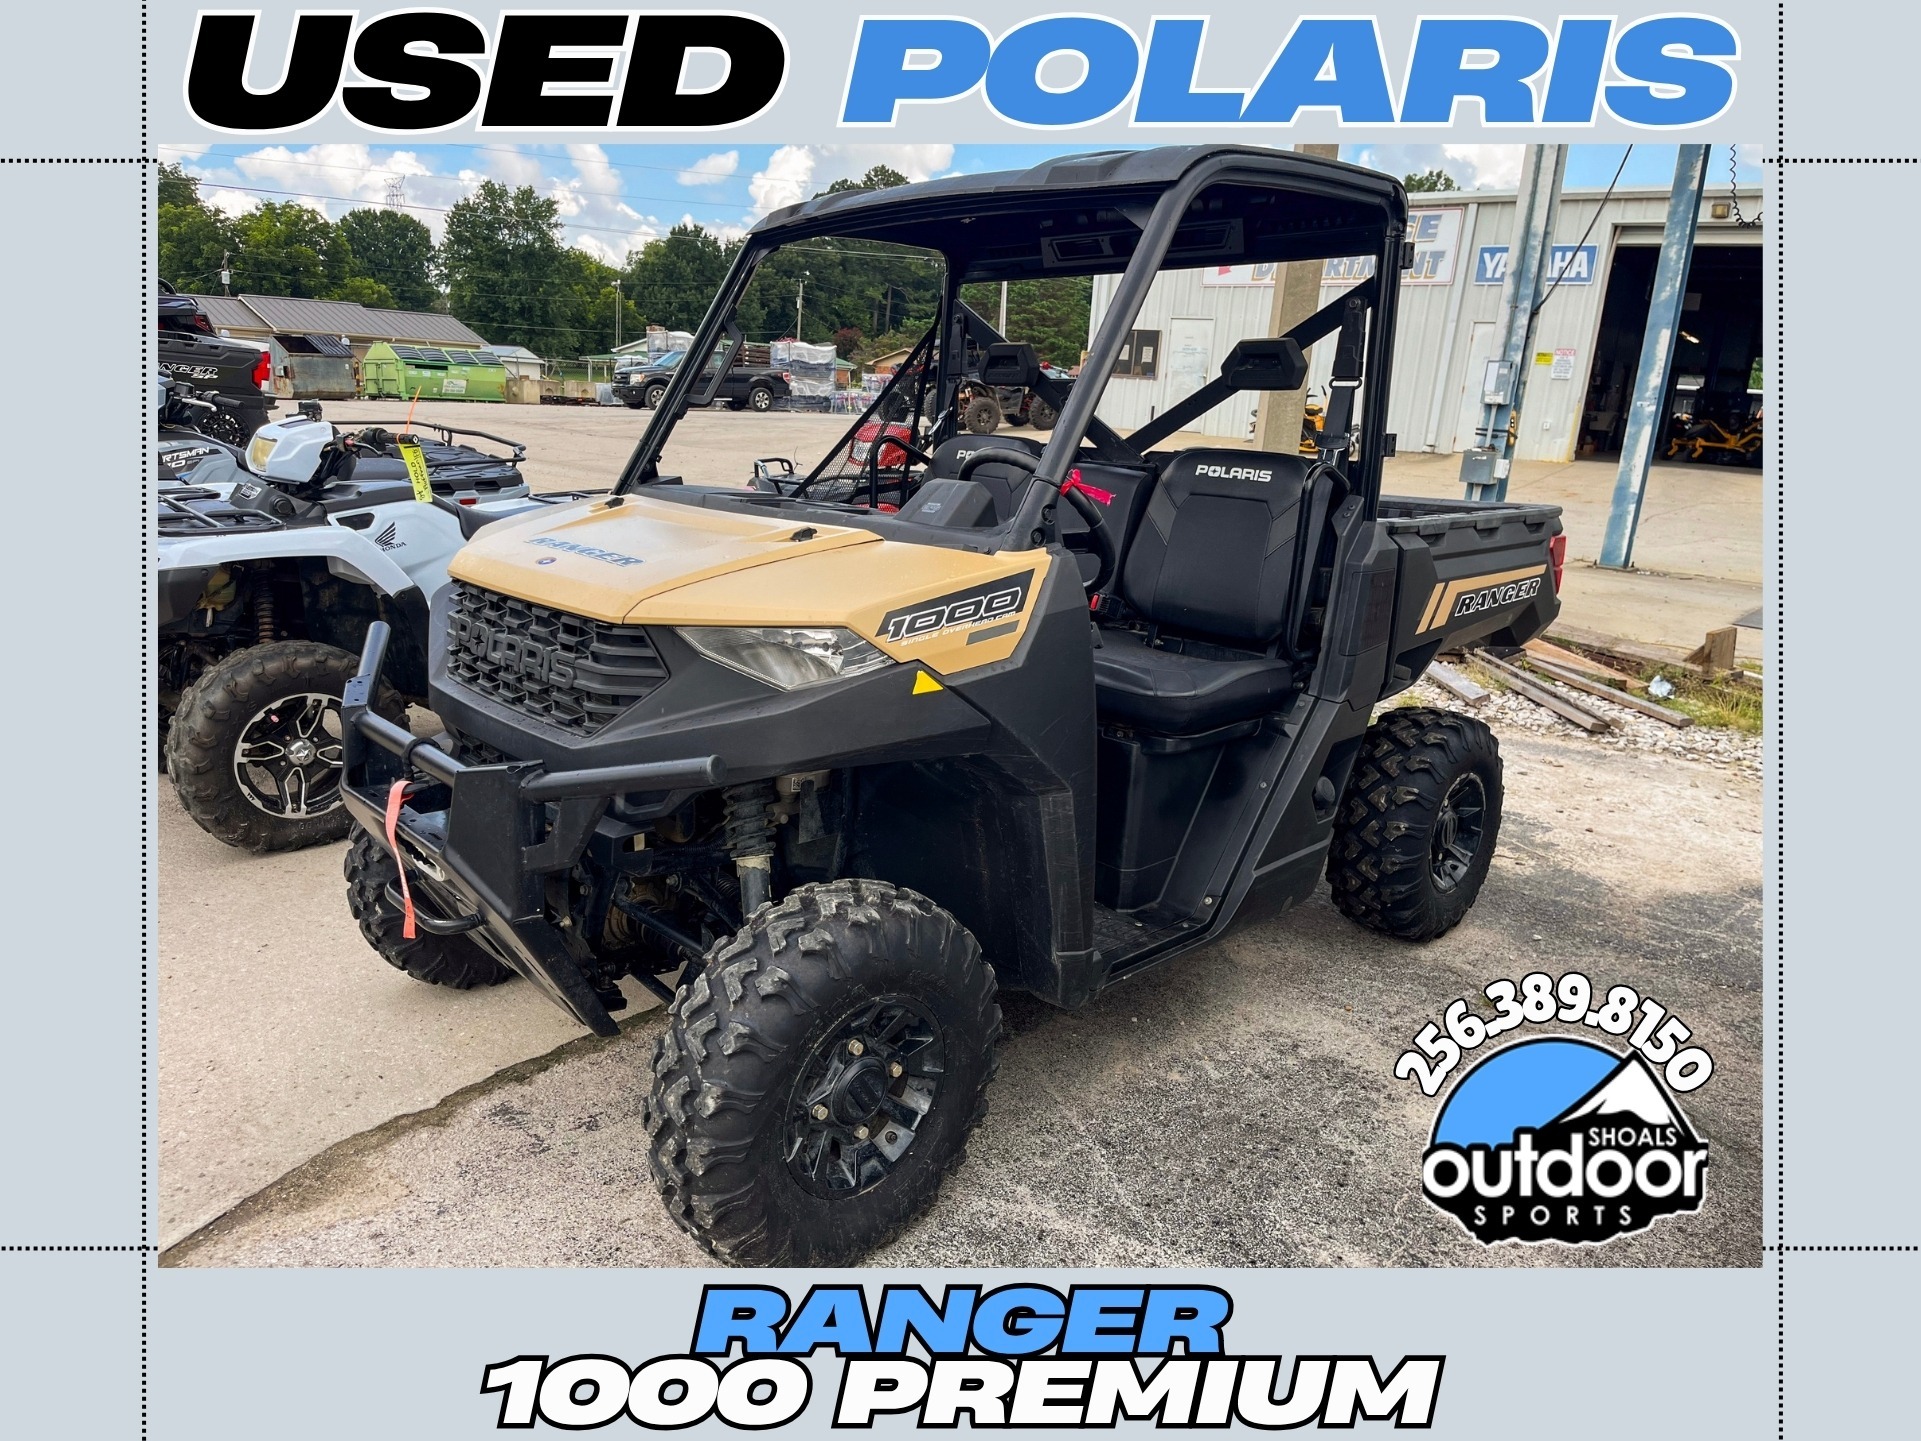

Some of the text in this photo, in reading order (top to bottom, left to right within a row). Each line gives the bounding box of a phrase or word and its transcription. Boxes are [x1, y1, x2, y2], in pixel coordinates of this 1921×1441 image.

[1483, 251, 1588, 279] YAHA
[158, 363, 218, 376] NGER
[162, 446, 210, 463] RTSMAN
[1195, 464, 1273, 483] POLARIS
[523, 537, 645, 567] RANGER
[1454, 577, 1541, 617] RANGER
[885, 586, 1022, 643] 1000
[900, 632, 939, 647] SINGLE
[942, 617, 995, 635] OVERHEAD
[455, 614, 577, 690] POLARIS
